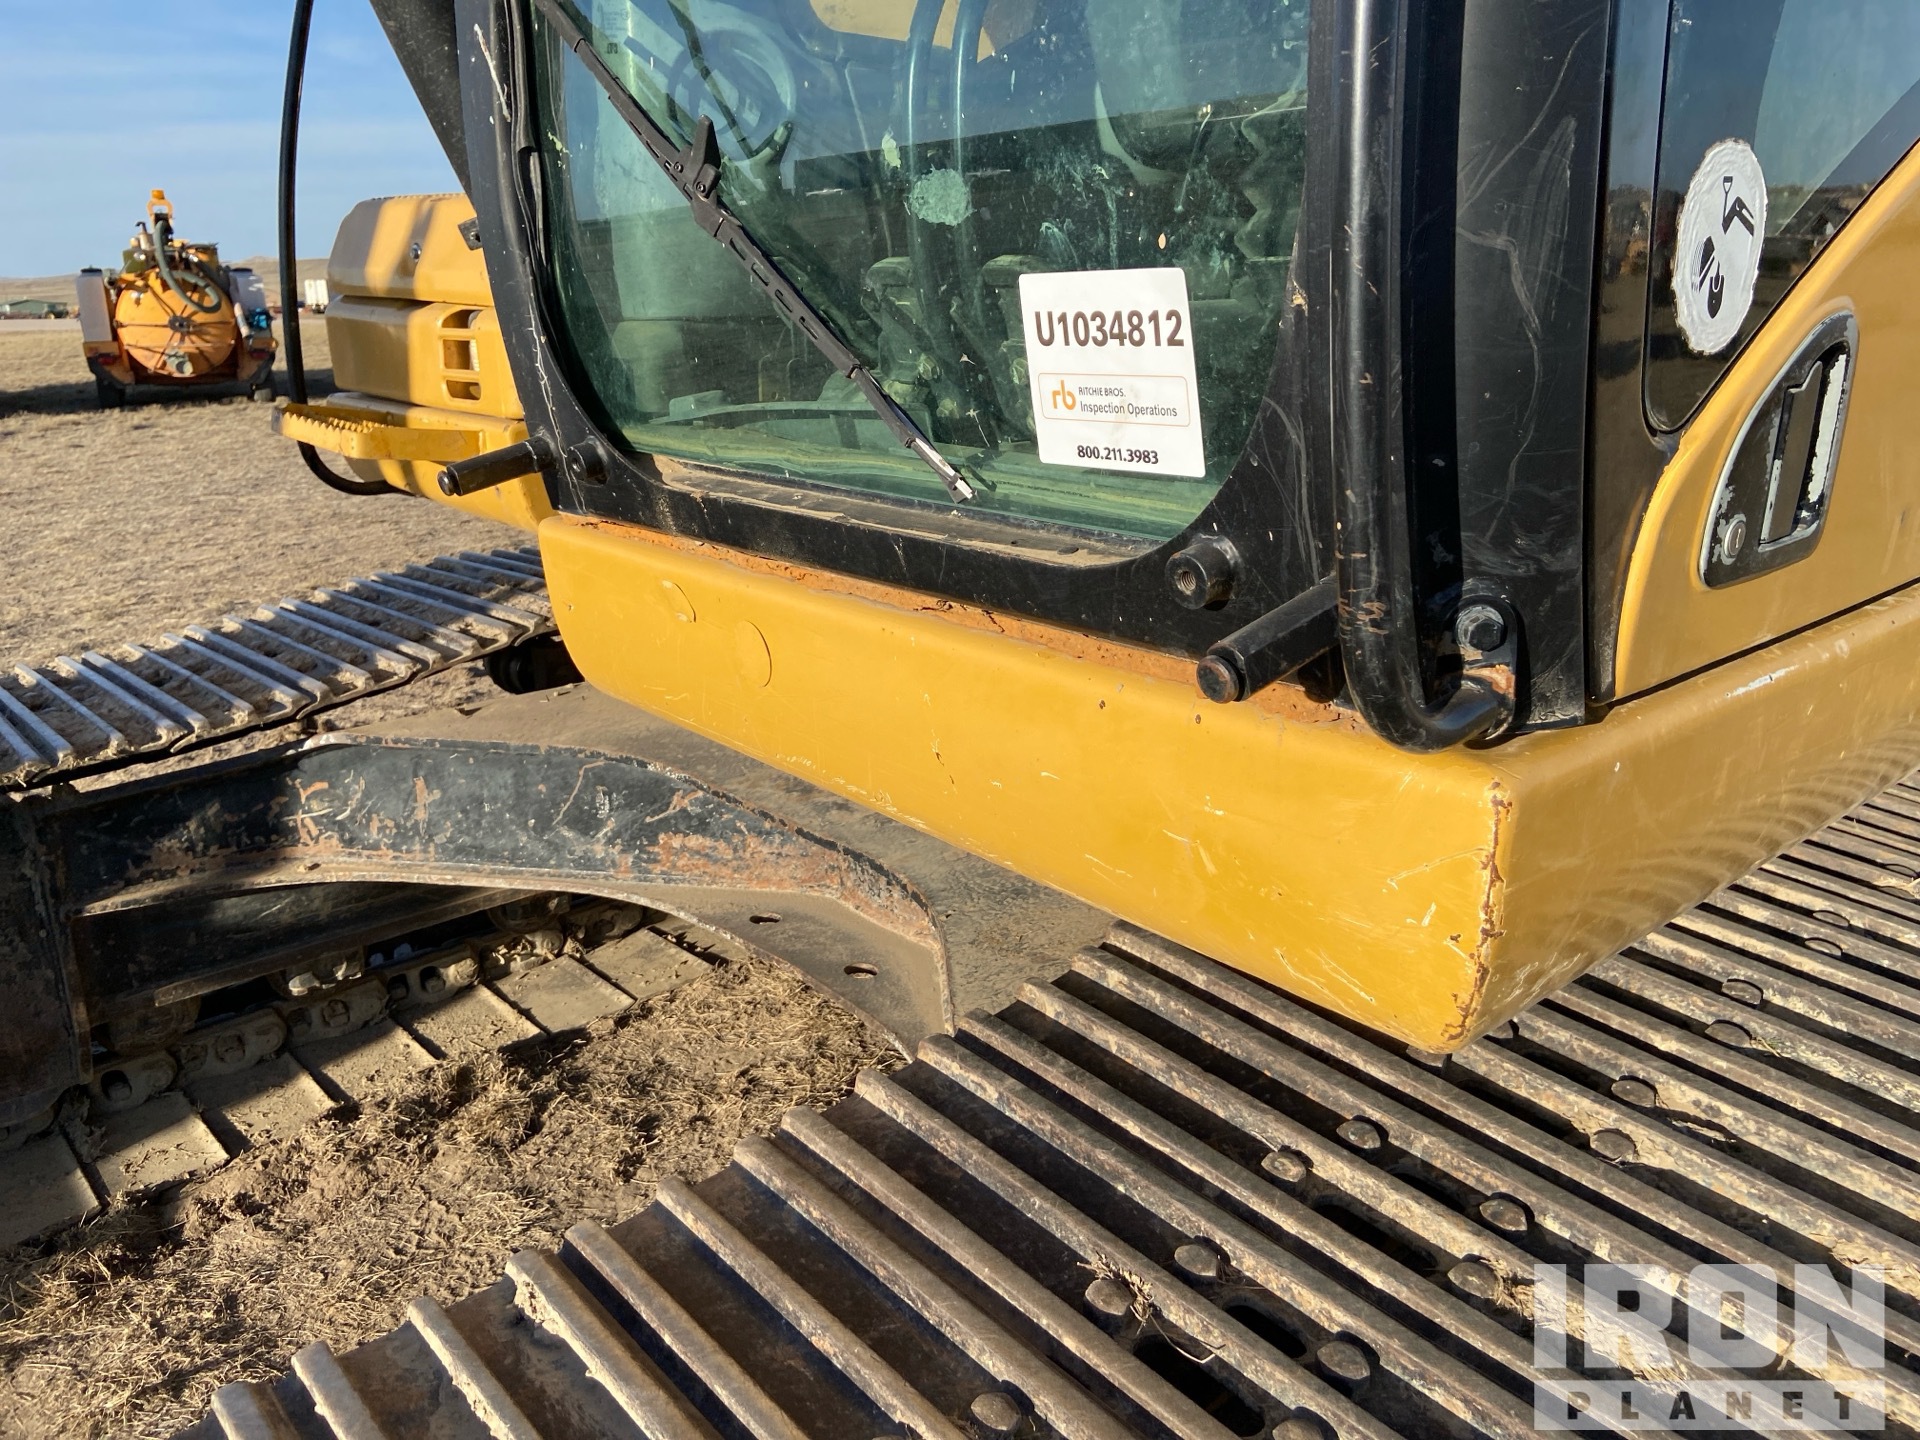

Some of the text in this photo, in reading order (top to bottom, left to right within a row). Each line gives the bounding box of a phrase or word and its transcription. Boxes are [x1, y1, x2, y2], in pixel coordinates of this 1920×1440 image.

[1035, 309, 1184, 347] U1034812
[1052, 380, 1076, 410] rb
[1079, 387, 1126, 397] RITCHIE BROS.
[1080, 401, 1178, 417] Inspection Operations
[1077, 445, 1159, 464] 800.211.3983
